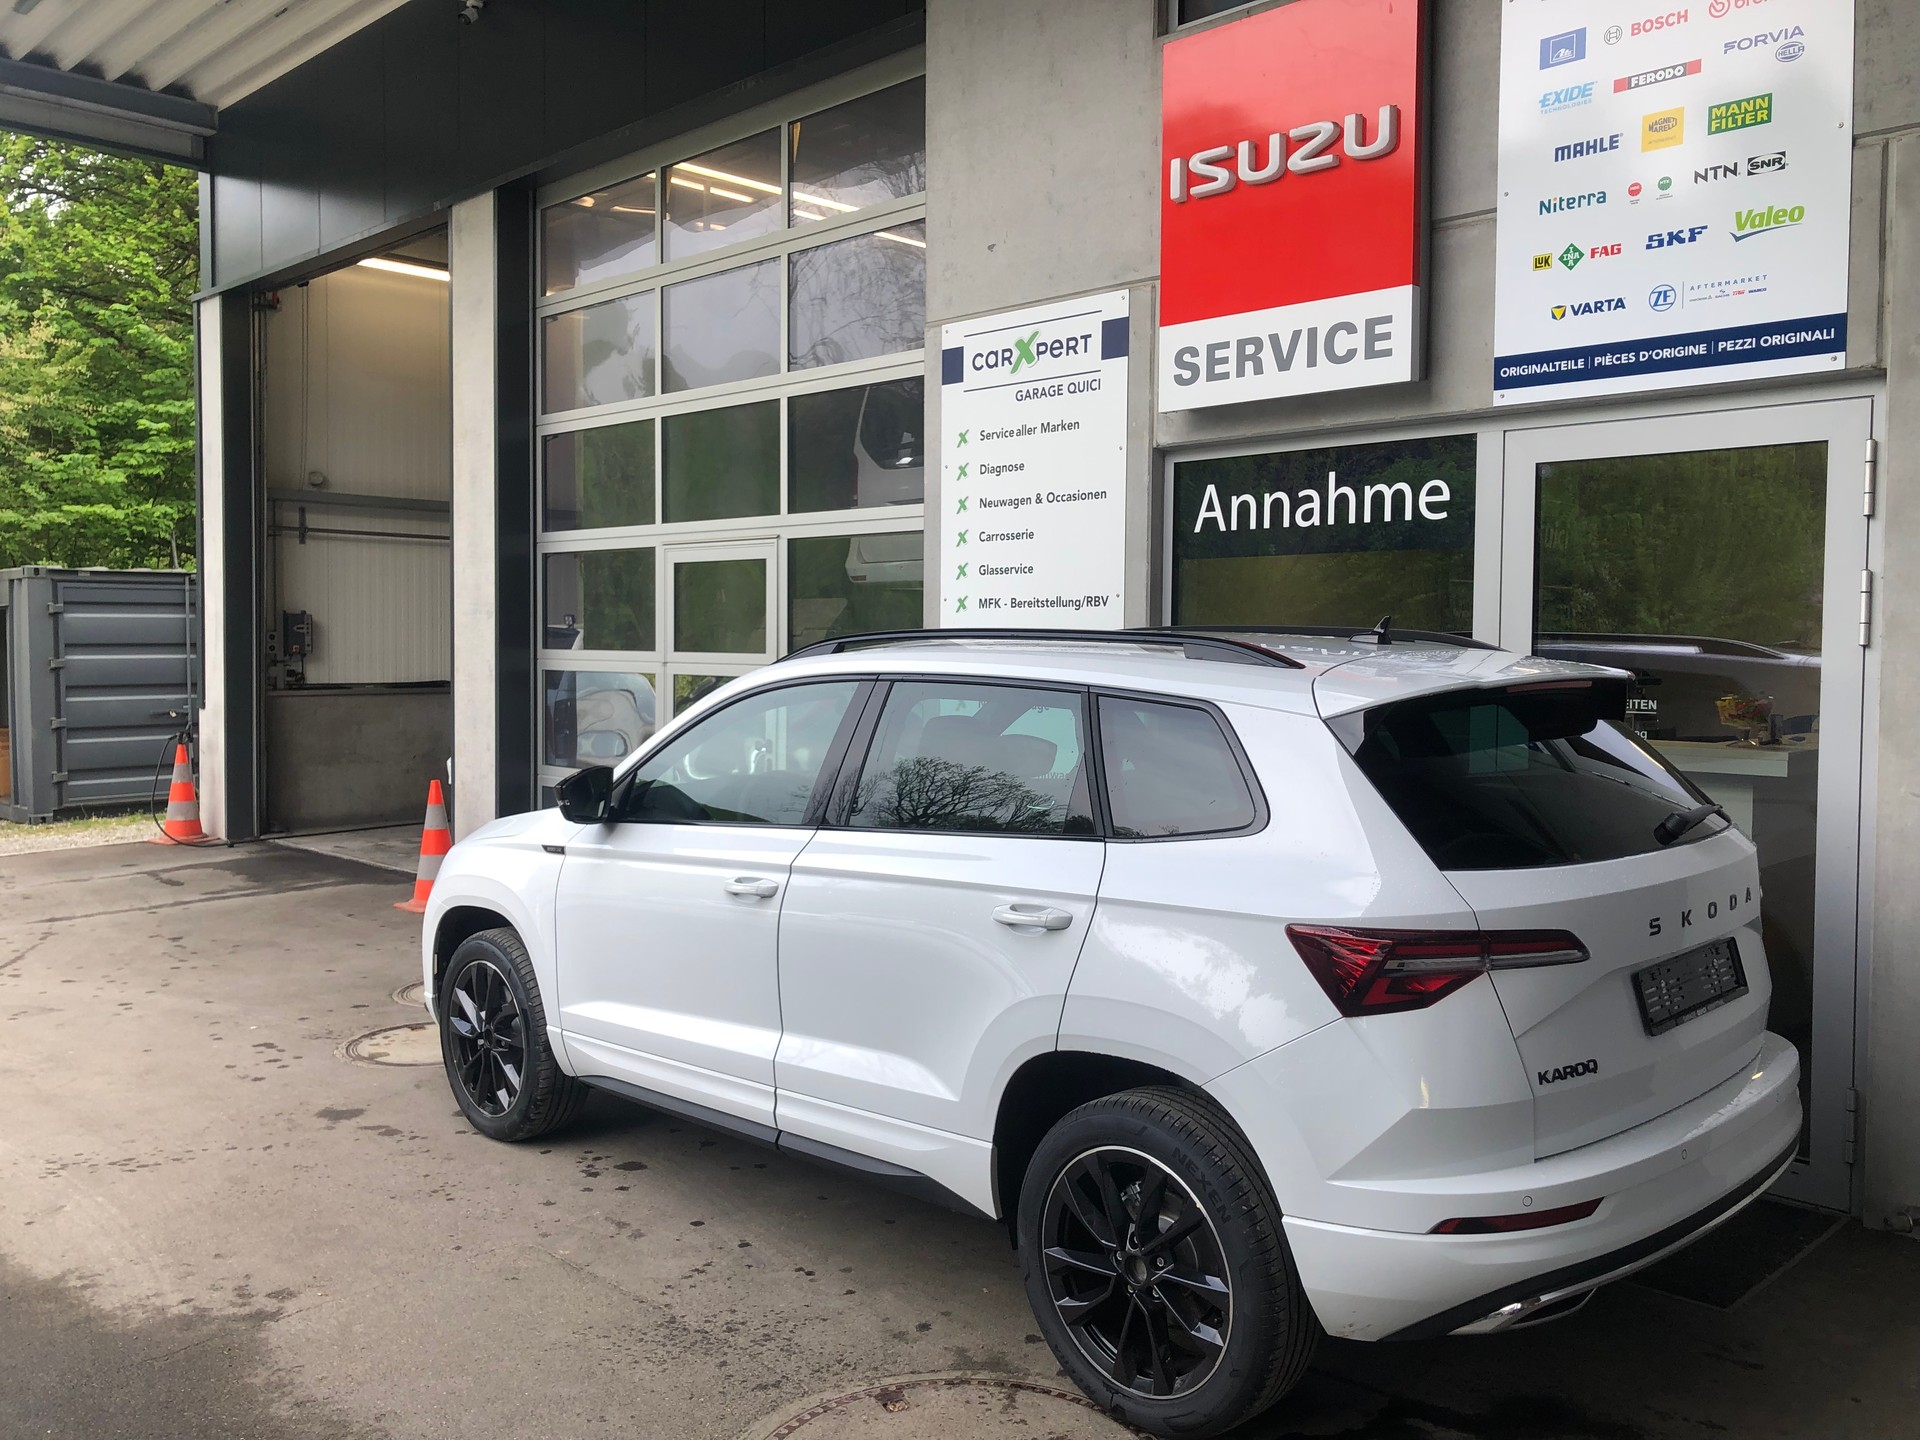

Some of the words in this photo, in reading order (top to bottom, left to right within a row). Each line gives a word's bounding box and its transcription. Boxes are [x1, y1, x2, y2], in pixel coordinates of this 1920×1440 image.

[1631, 9, 1688, 36] BOSCH
[1723, 25, 1804, 54] FORVIA
[1777, 44, 1805, 57] HELLA
[1630, 65, 1684, 88] FERODO
[1539, 81, 1594, 108] EXIDE
[1540, 98, 1592, 114] TECHNOLOGIES
[1711, 96, 1769, 119] MANN
[1711, 109, 1769, 132] FILTER
[1170, 104, 1401, 204] ISUZU
[1554, 133, 1620, 162] MAHLE
[1694, 162, 1738, 184] NTN
[1749, 157, 1784, 170] SNR
[1539, 190, 1607, 215] Niterra
[1734, 205, 1805, 232] Valeo
[1645, 225, 1708, 250] SKF
[1590, 243, 1622, 259] FAG
[1690, 274, 1768, 291] AFTERMARKET
[1570, 297, 1627, 316] VARTA
[1173, 315, 1393, 386] SERVICE
[1500, 358, 1585, 378] ORIGINALTEILE
[1594, 353, 1636, 367] PIÈCES
[1639, 344, 1707, 363] D'ORIGINE
[1718, 338, 1756, 352] PEZZI
[1760, 328, 1835, 347] ORIGINALI
[1015, 384, 1064, 402] GARAGE
[1067, 378, 1101, 394] QUICI
[979, 426, 1015, 442] Service
[1016, 423, 1037, 437] aller
[1040, 419, 1080, 434] Marken
[979, 461, 1025, 477] Diagnose
[979, 495, 1032, 509] Neuwagen
[1035, 492, 1043, 504] &
[1046, 489, 1107, 504] Occasionen
[1193, 471, 1450, 534] Annahme
[978, 529, 1035, 543] Carrosserie
[978, 563, 1034, 576] Glasservice
[978, 597, 1002, 609] MFK
[1010, 595, 1109, 611] Bereitstellung/RBV
[1649, 887, 1752, 936] SKODA
[1537, 1058, 1598, 1085] KAROQ
[1172, 1147, 1232, 1224] NEXEN
